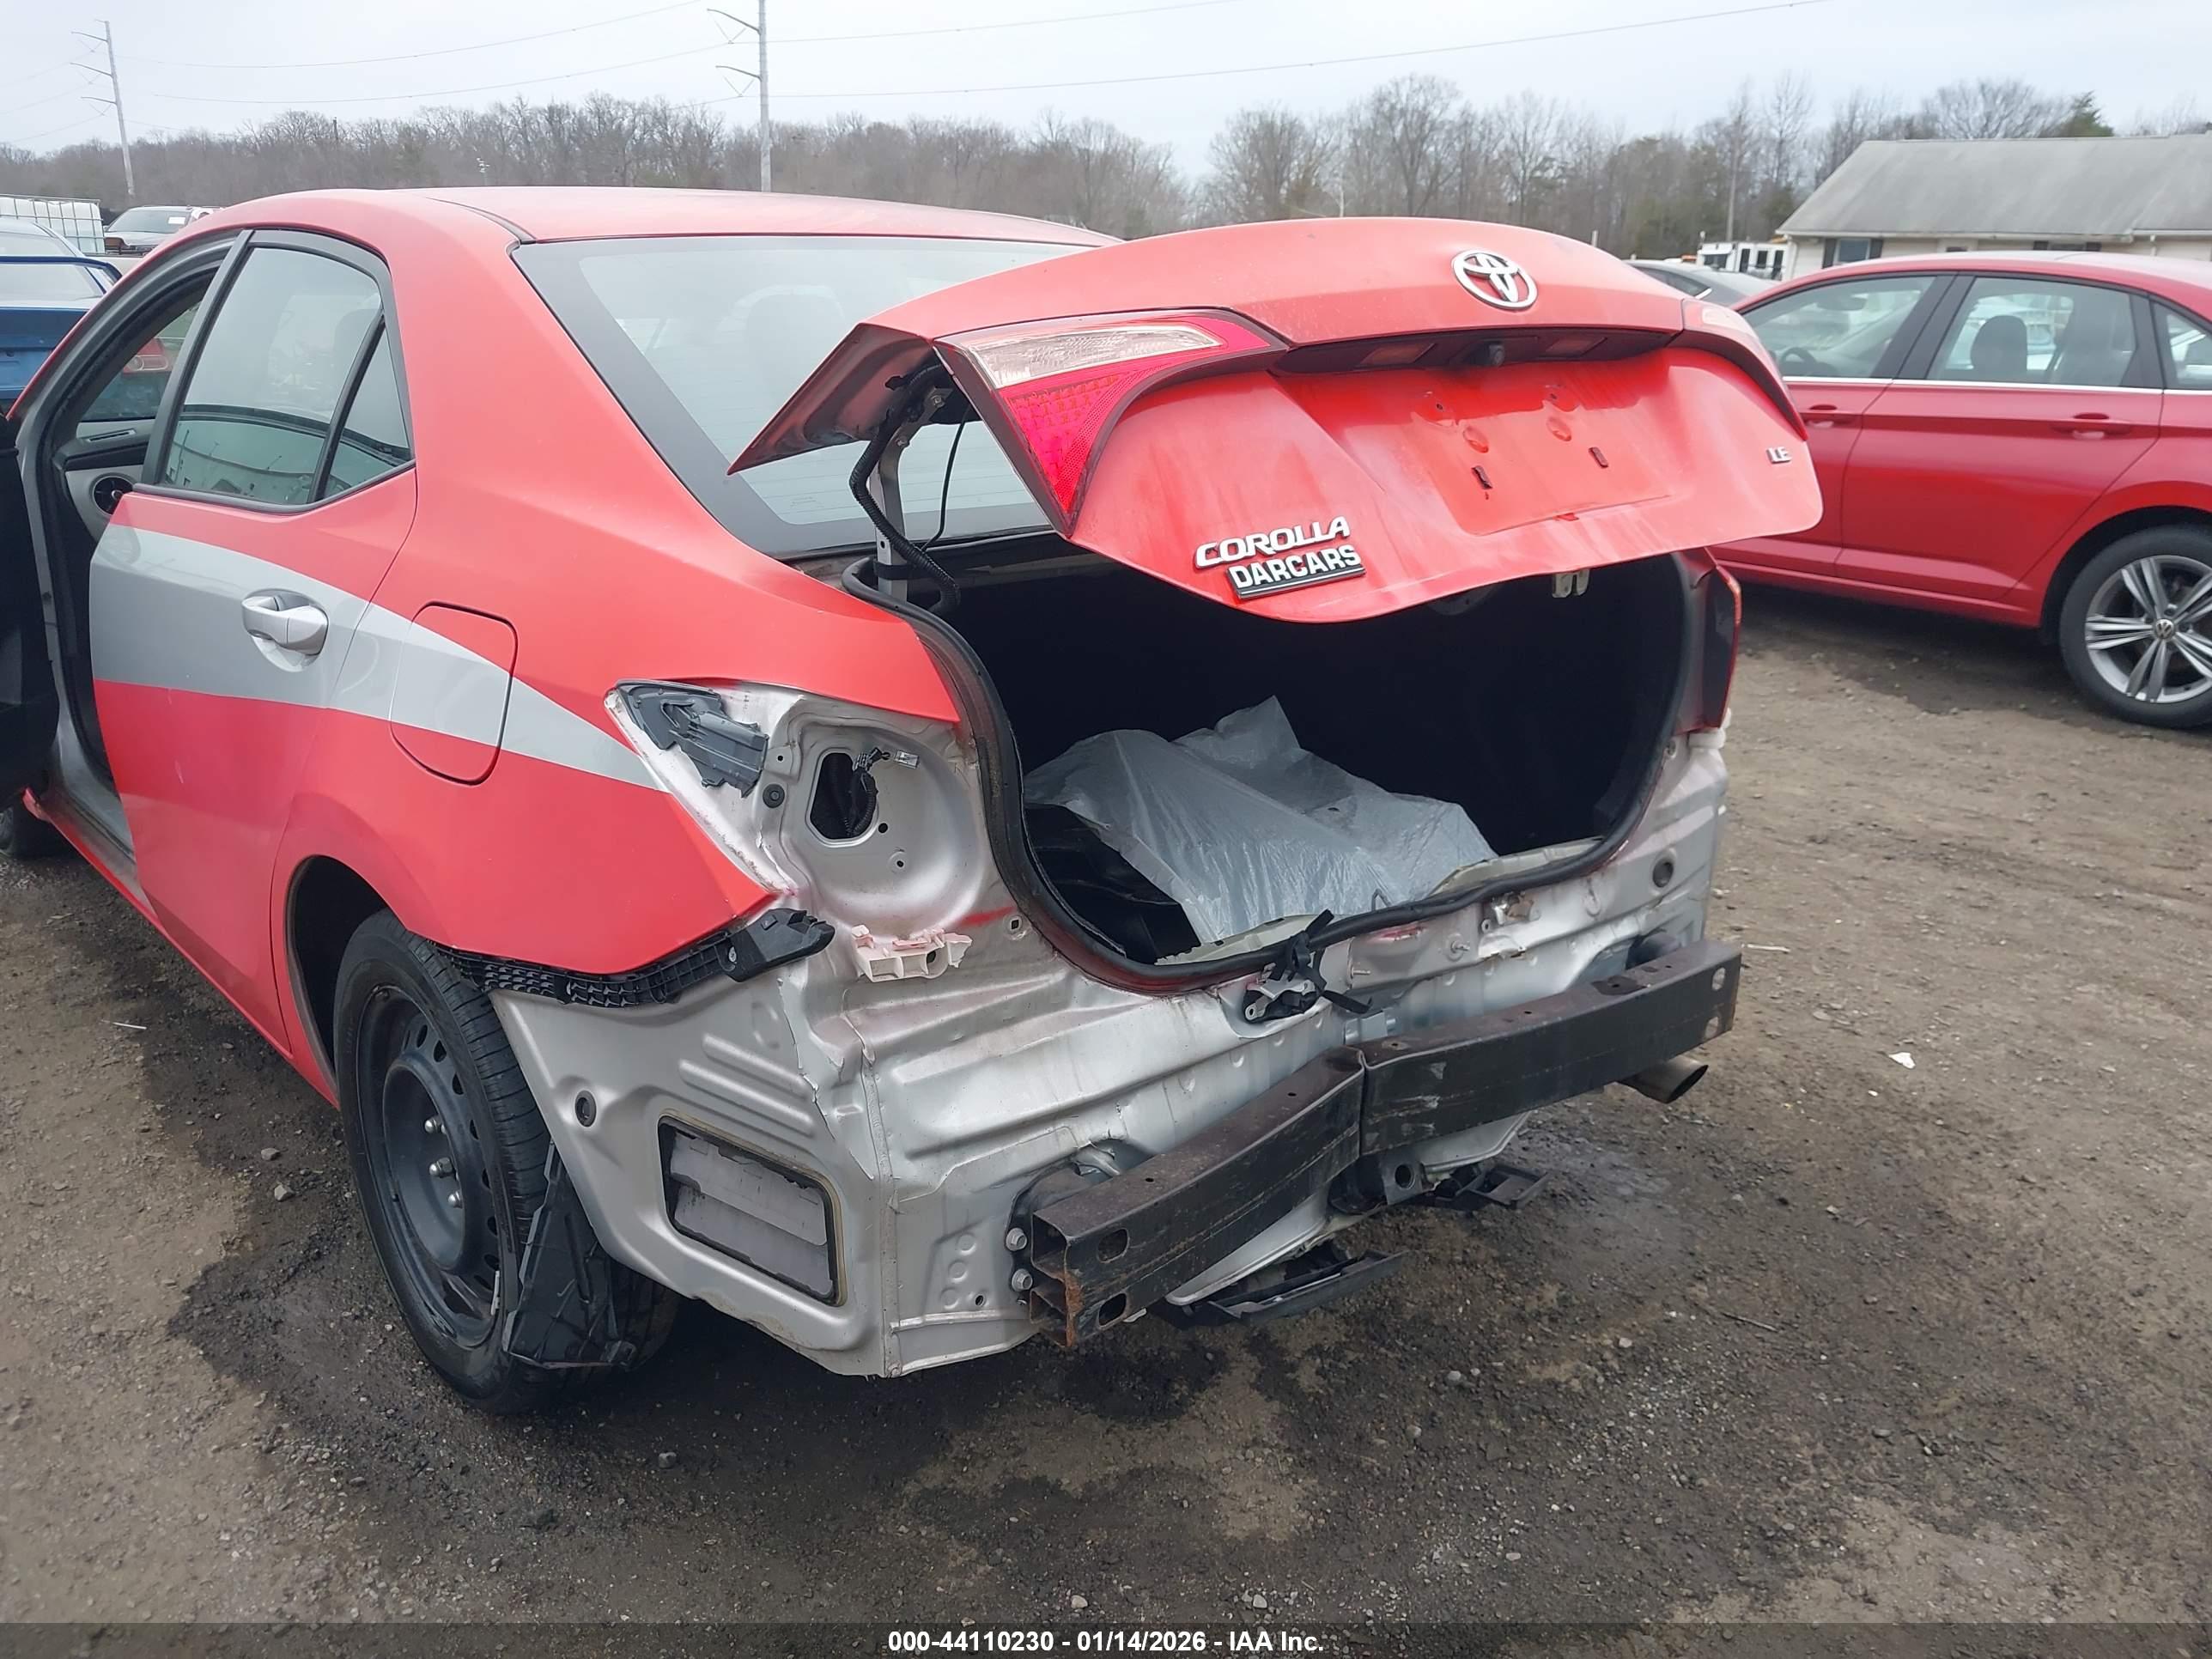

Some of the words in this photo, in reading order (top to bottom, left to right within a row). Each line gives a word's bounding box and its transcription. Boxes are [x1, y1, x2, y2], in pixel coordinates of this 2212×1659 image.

[1766, 447, 1792, 464] LE
[1194, 516, 1351, 568] COROLLA
[1228, 544, 1362, 589] DARCARS
